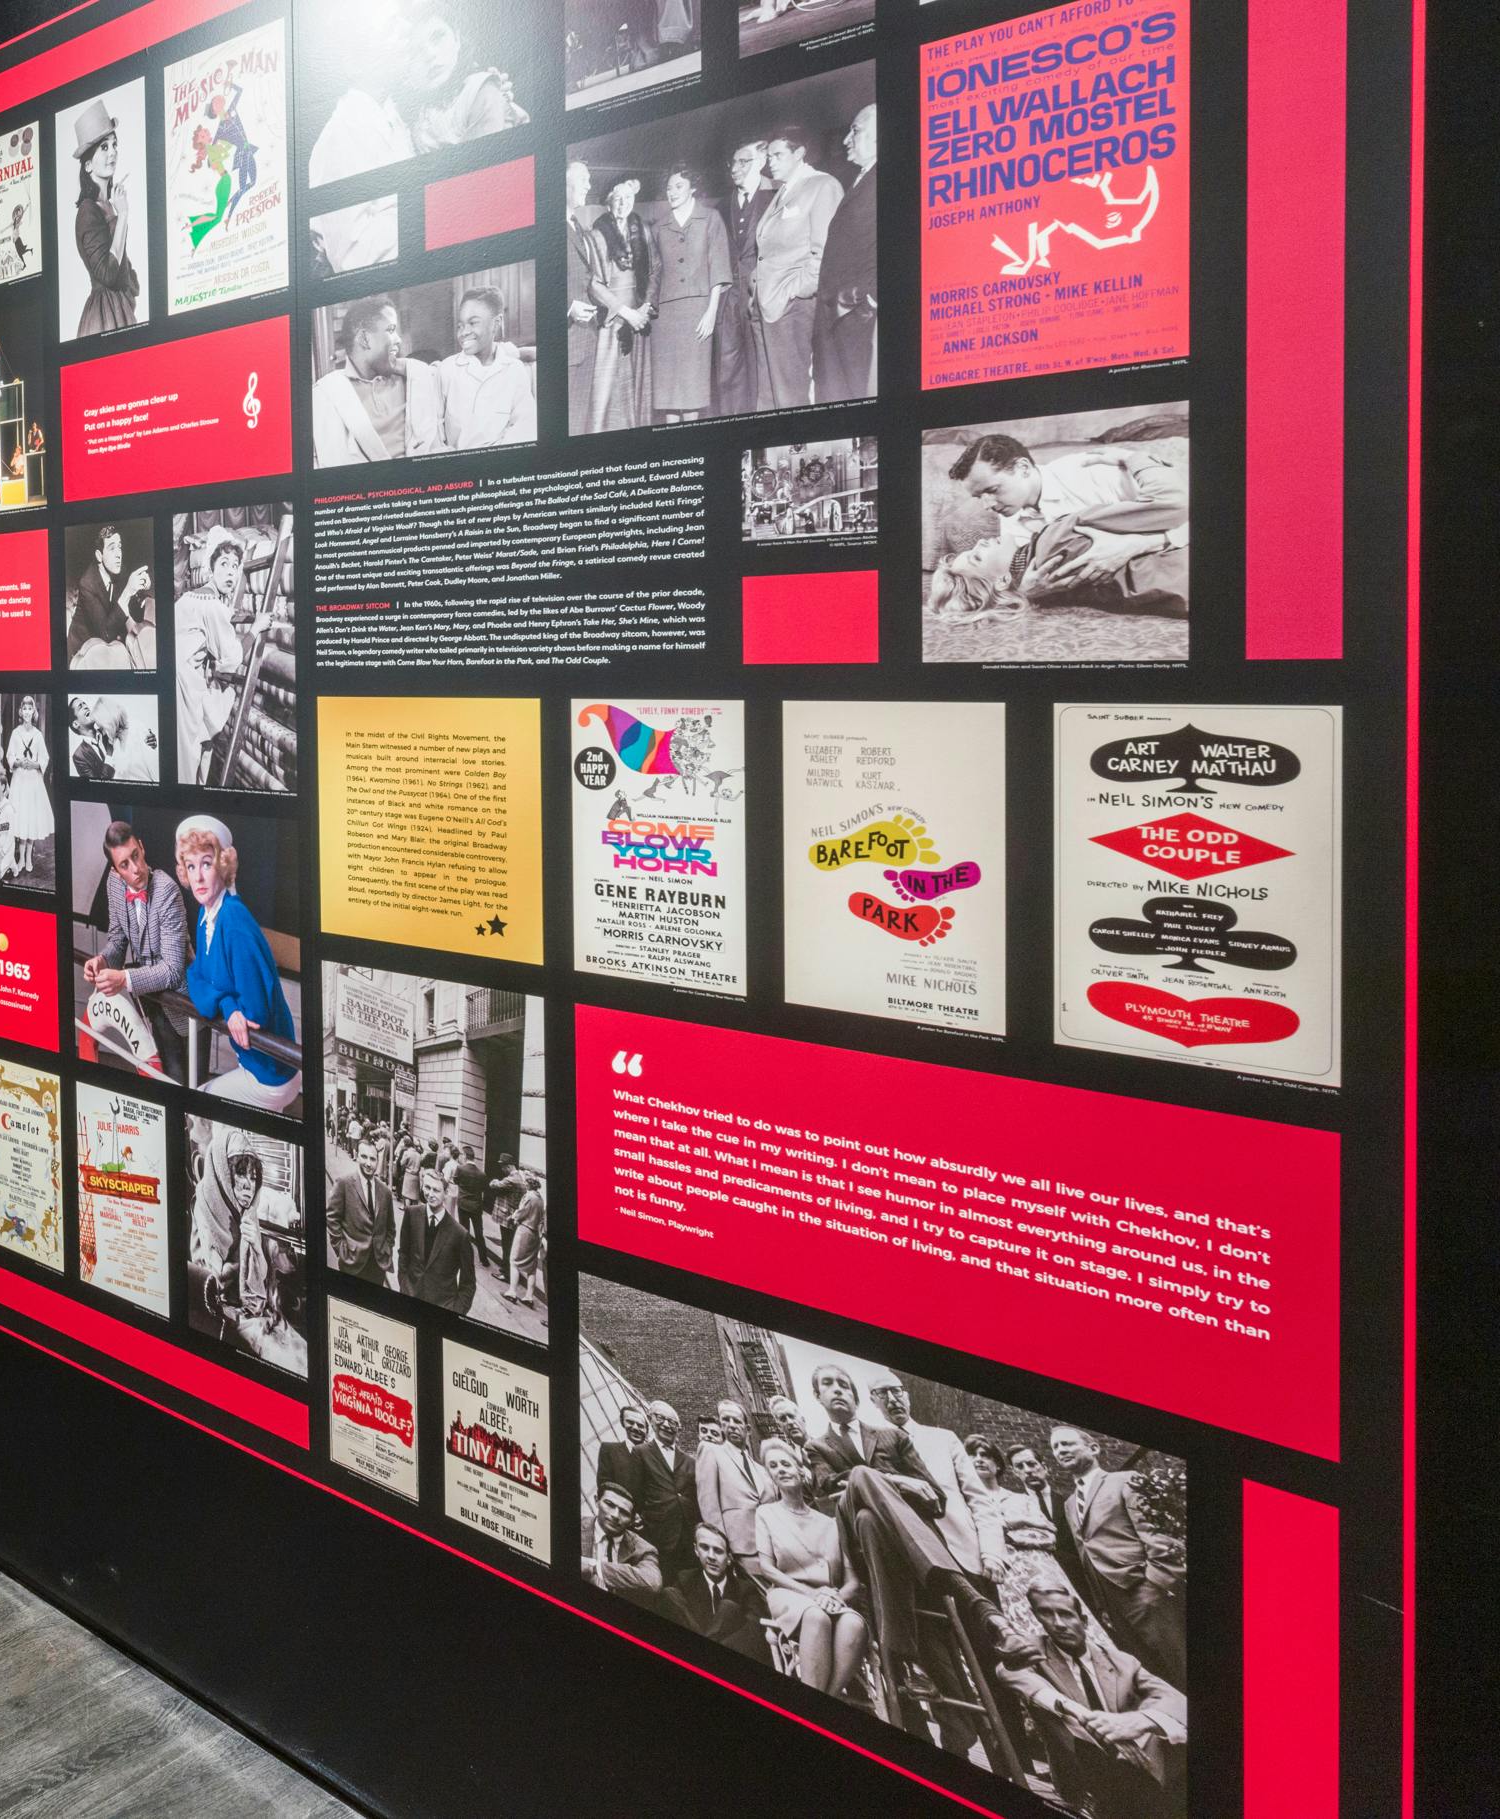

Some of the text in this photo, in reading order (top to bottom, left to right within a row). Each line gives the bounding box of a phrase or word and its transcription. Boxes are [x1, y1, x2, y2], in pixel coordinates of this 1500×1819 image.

[928, 12, 1176, 102] IONESCO'S
[172, 48, 278, 132] MUSIC MAN
[172, 78, 196, 104] THE
[928, 55, 1176, 141] ELI WALLACH
[928, 88, 1176, 169] ZERO MOSTEL
[928, 123, 1176, 208] RHINOCEROS
[249, 181, 278, 206] ROBERT
[235, 192, 281, 226] PRESTON
[174, 289, 216, 306] MAJESTIC
[930, 272, 1060, 306] MORRIS CARNOVSKY
[929, 367, 980, 385] LONGACRE
[84, 392, 178, 418] Gray skies are gonna clear up
[84, 422, 95, 432] Put
[96, 421, 106, 430] on
[112, 416, 132, 428] happy
[133, 413, 148, 424] face!
[327, 584, 357, 593] performed
[358, 583, 365, 591] by
[366, 582, 380, 590] Alan
[380, 581, 406, 589] Bennett,
[424, 578, 443, 586] Cook,
[444, 578, 466, 586] Dudley
[468, 576, 490, 584] Moore,
[506, 574, 538, 582] Jonathan
[540, 572, 562, 580] Miller.
[586, 752, 604, 762] 2nd
[1124, 742, 1160, 756] ART
[1200, 744, 1271, 760] WALTER
[580, 763, 610, 775] HAPPY
[1107, 758, 1180, 775] CARNEY
[1191, 759, 1276, 776] MATTHAU
[582, 774, 607, 787] YEAR
[1098, 792, 1136, 808] NEIL
[1142, 794, 1214, 810] SIMON'S
[1220, 802, 1242, 811] NEW
[602, 830, 704, 850] BLOW
[607, 819, 714, 841] COME
[1138, 826, 1239, 845] THE ODD
[612, 842, 712, 864] YOUR
[816, 831, 910, 866] BAREFOOT
[1142, 844, 1241, 866] COUPLE
[613, 854, 718, 877] HORN
[906, 866, 971, 894] IN THE
[594, 883, 726, 910] GENE RAYBURN
[862, 898, 920, 932] PARK
[603, 928, 723, 951] MORRIS CARNOVSKY
[586, 955, 738, 984] BROOKS ATKINSON THEATRE
[0, 986, 12, 994] John
[18, 988, 40, 1001] Kennedy
[886, 972, 978, 996] MIKE NICHOLS
[0, 999, 32, 1012] assassinated
[346, 998, 404, 1026] BAREFOOT
[888, 997, 980, 1017] BILTMORE THEATRE
[1125, 1002, 1251, 1028] PLYMOUTH THEATRE
[92, 1000, 140, 1054] CORONIA
[341, 1004, 410, 1037] IN THE PARK
[1, 1112, 40, 1136] Camelot
[97, 1120, 140, 1136] JULIE HARRIS
[613, 1088, 1272, 1240] What Chekhov tried to do was to point out how absurdly we all live our lives, and that's
[90, 1176, 154, 1196] SKYSCRAPER
[614, 1184, 686, 1212] not is funny.
[334, 1354, 396, 1389] EDWARD ALBEE'S
[464, 1367, 476, 1378] JOHN
[452, 1371, 488, 1398] GIELGUD
[514, 1386, 529, 1398] IRENE
[506, 1392, 540, 1419] WORTH
[374, 1407, 413, 1438] WOOLF?
[454, 1432, 542, 1488] TINY ALICE
[460, 1506, 534, 1550] BILLY ROSE THEATRE
